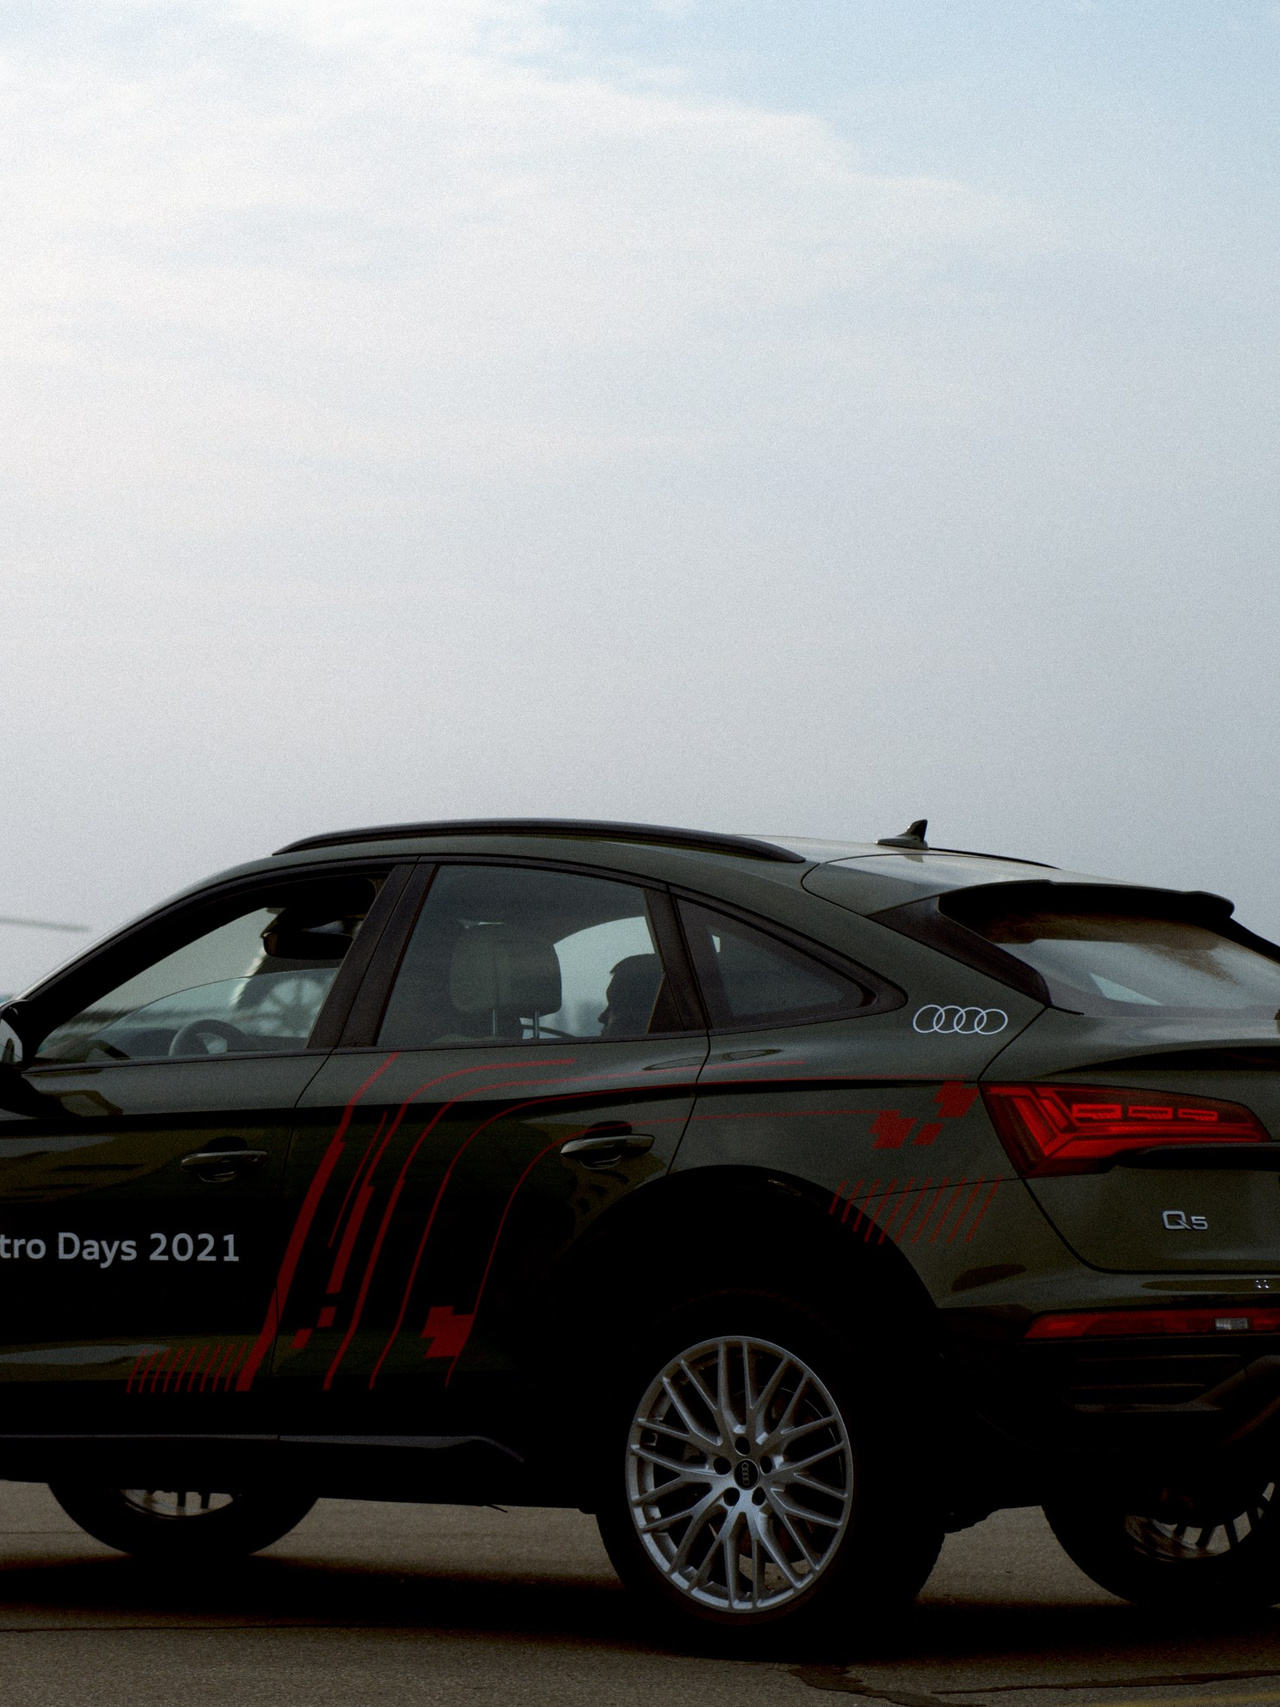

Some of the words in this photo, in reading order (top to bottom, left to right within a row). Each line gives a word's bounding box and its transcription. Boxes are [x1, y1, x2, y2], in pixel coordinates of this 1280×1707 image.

[1163, 1211, 1207, 1229] Q5
[59, 1232, 137, 1268] Days
[150, 1233, 239, 1261] 2021
